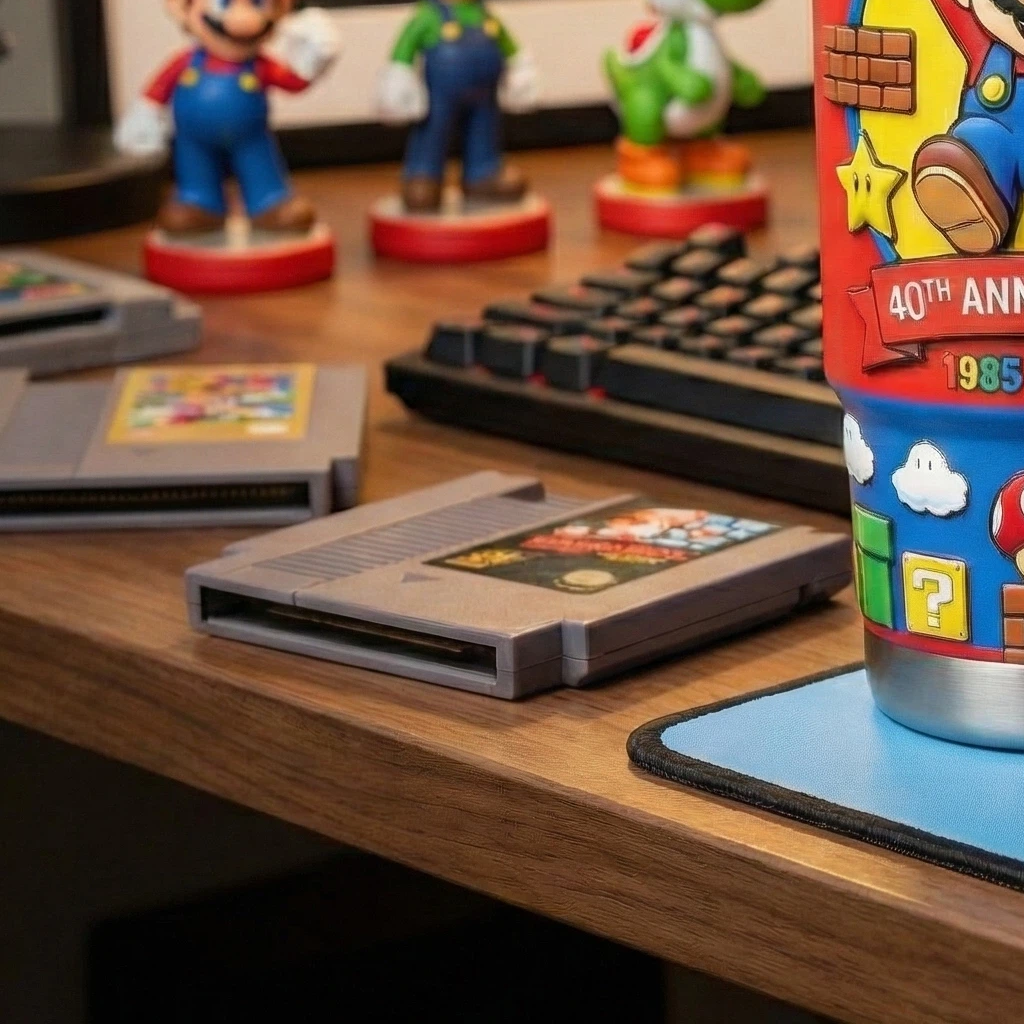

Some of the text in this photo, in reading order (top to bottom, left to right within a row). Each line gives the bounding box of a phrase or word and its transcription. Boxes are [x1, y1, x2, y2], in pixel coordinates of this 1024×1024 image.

[889, 277, 951, 321] 40TH
[942, 351, 1024, 394] 1985
[912, 568, 953, 629] ?
